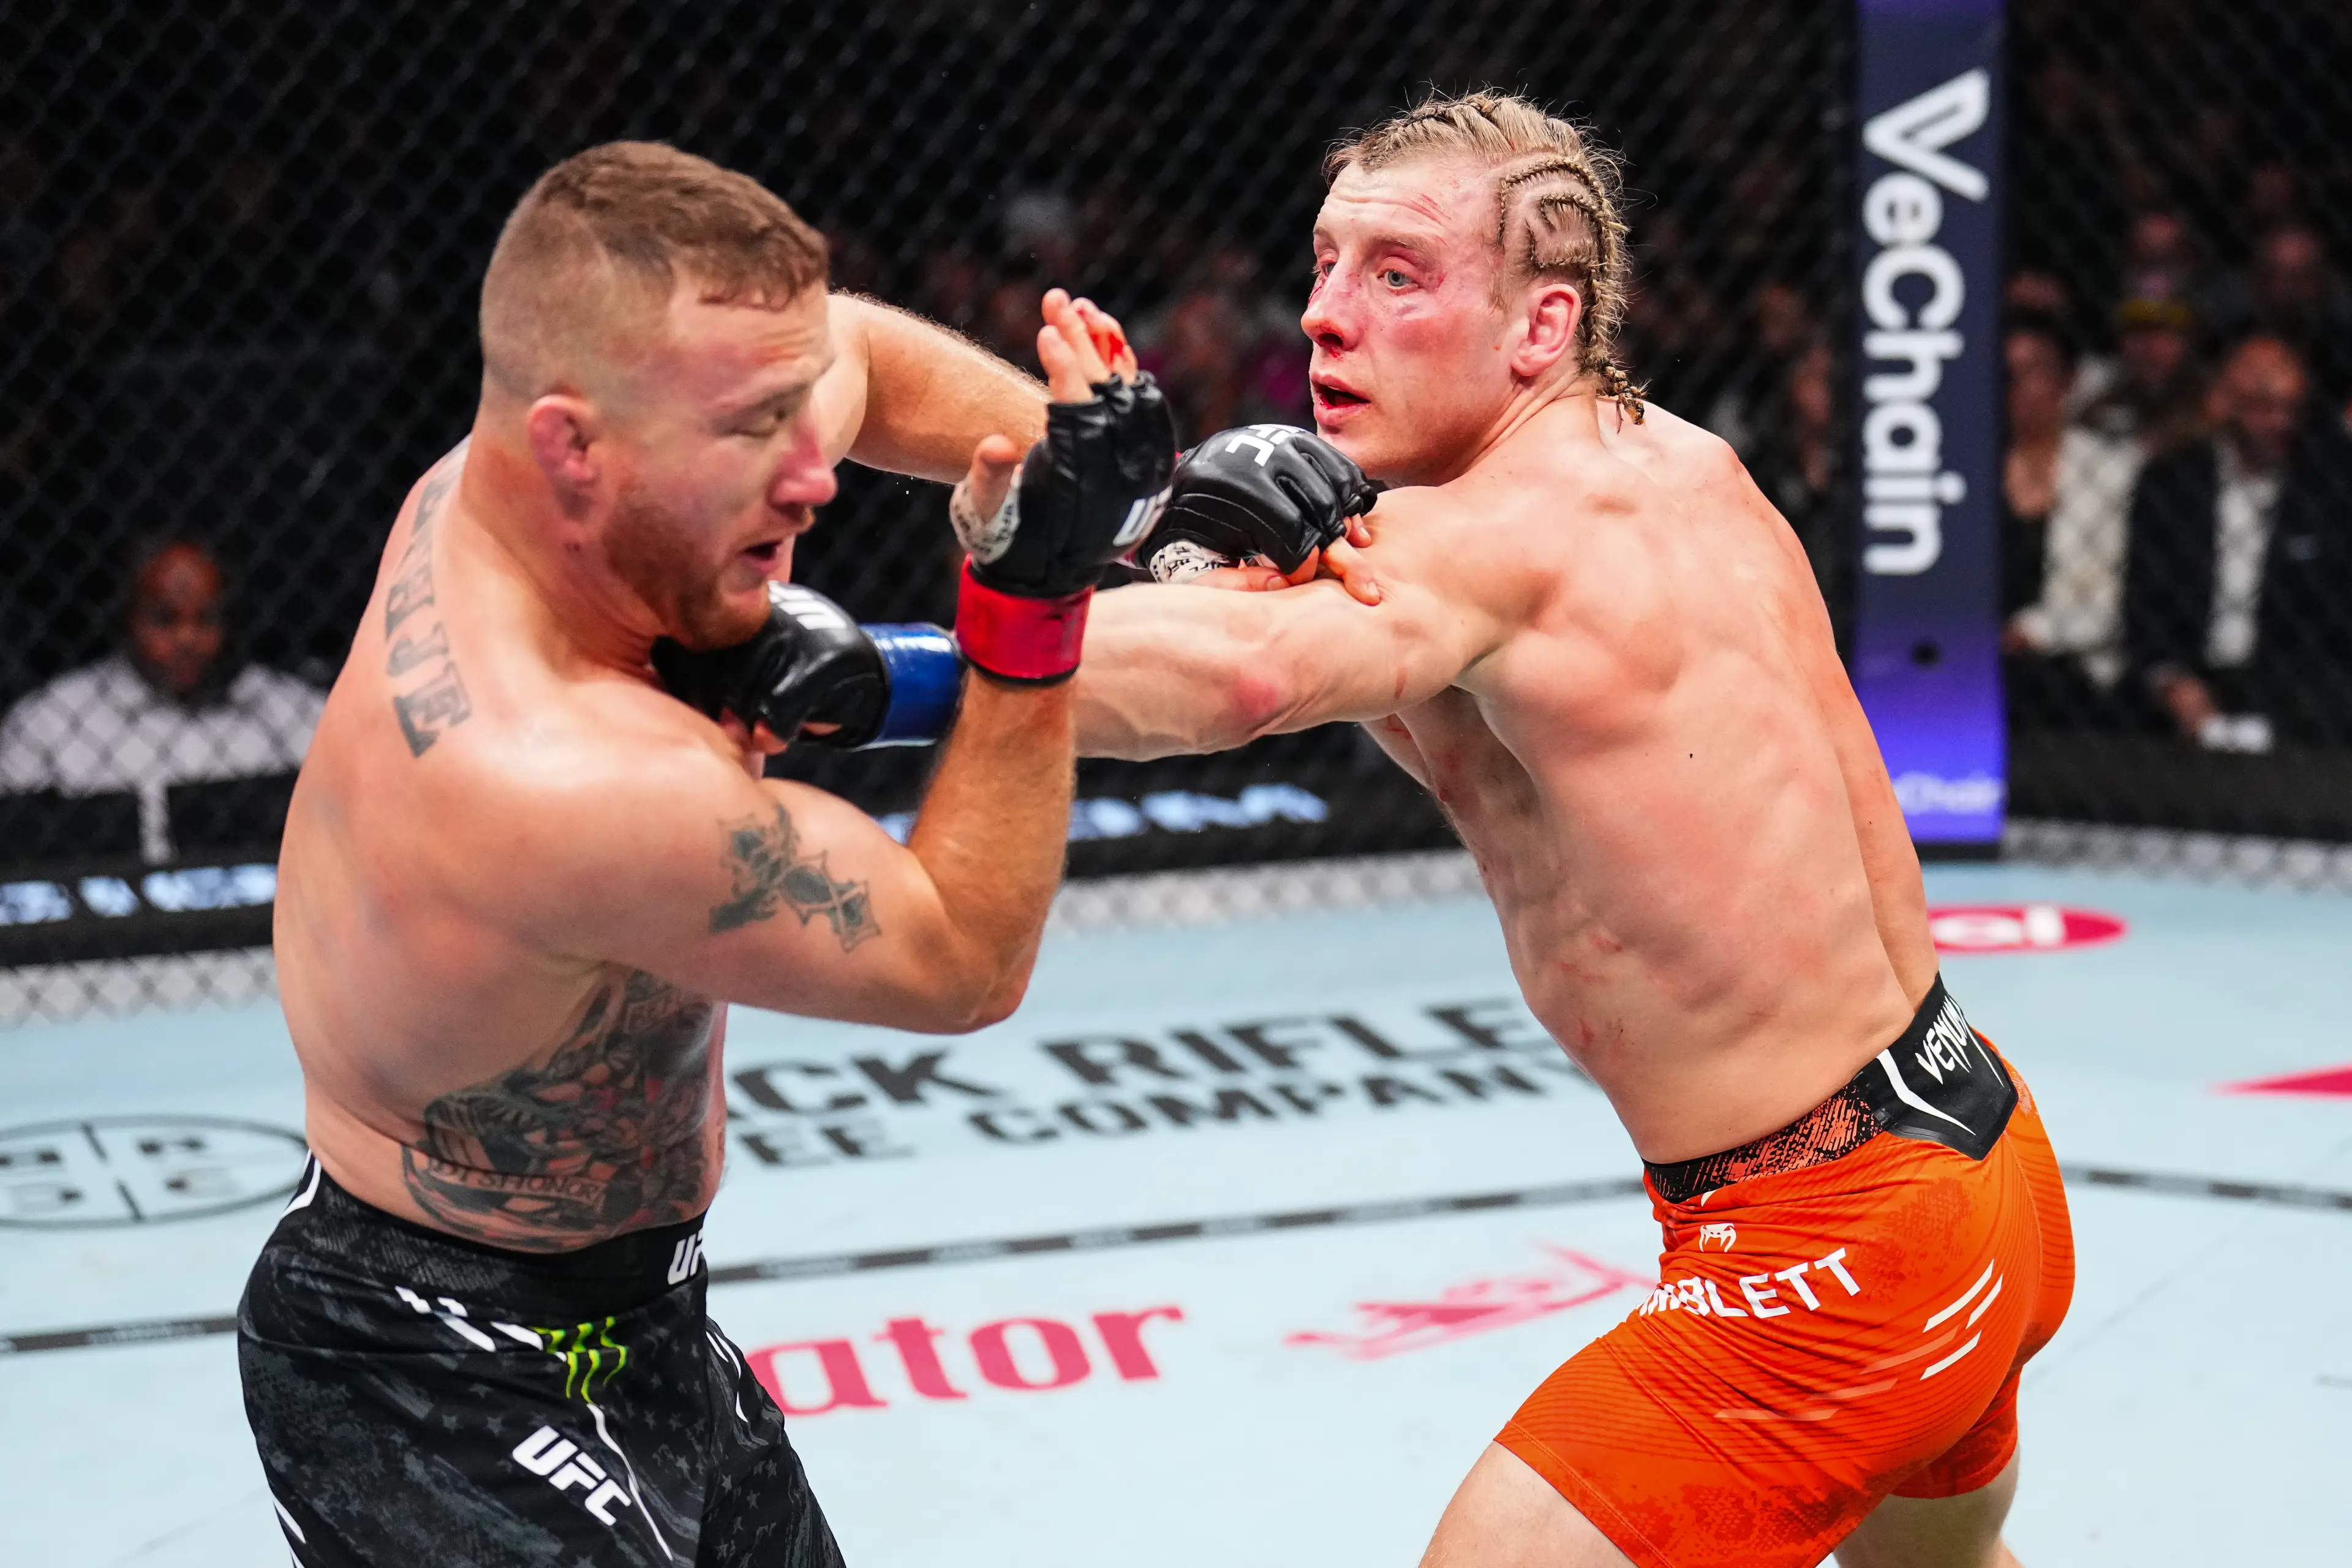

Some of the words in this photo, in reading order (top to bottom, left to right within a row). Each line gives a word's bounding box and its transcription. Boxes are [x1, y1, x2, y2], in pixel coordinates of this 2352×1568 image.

[1863, 67, 1990, 576] VeChain
[729, 1046, 1005, 1116] CK
[1038, 998, 1559, 1084] RIFLE
[737, 1118, 916, 1169] EE
[744, 1305, 1186, 1417] ator
[513, 1425, 631, 1526] UFC
